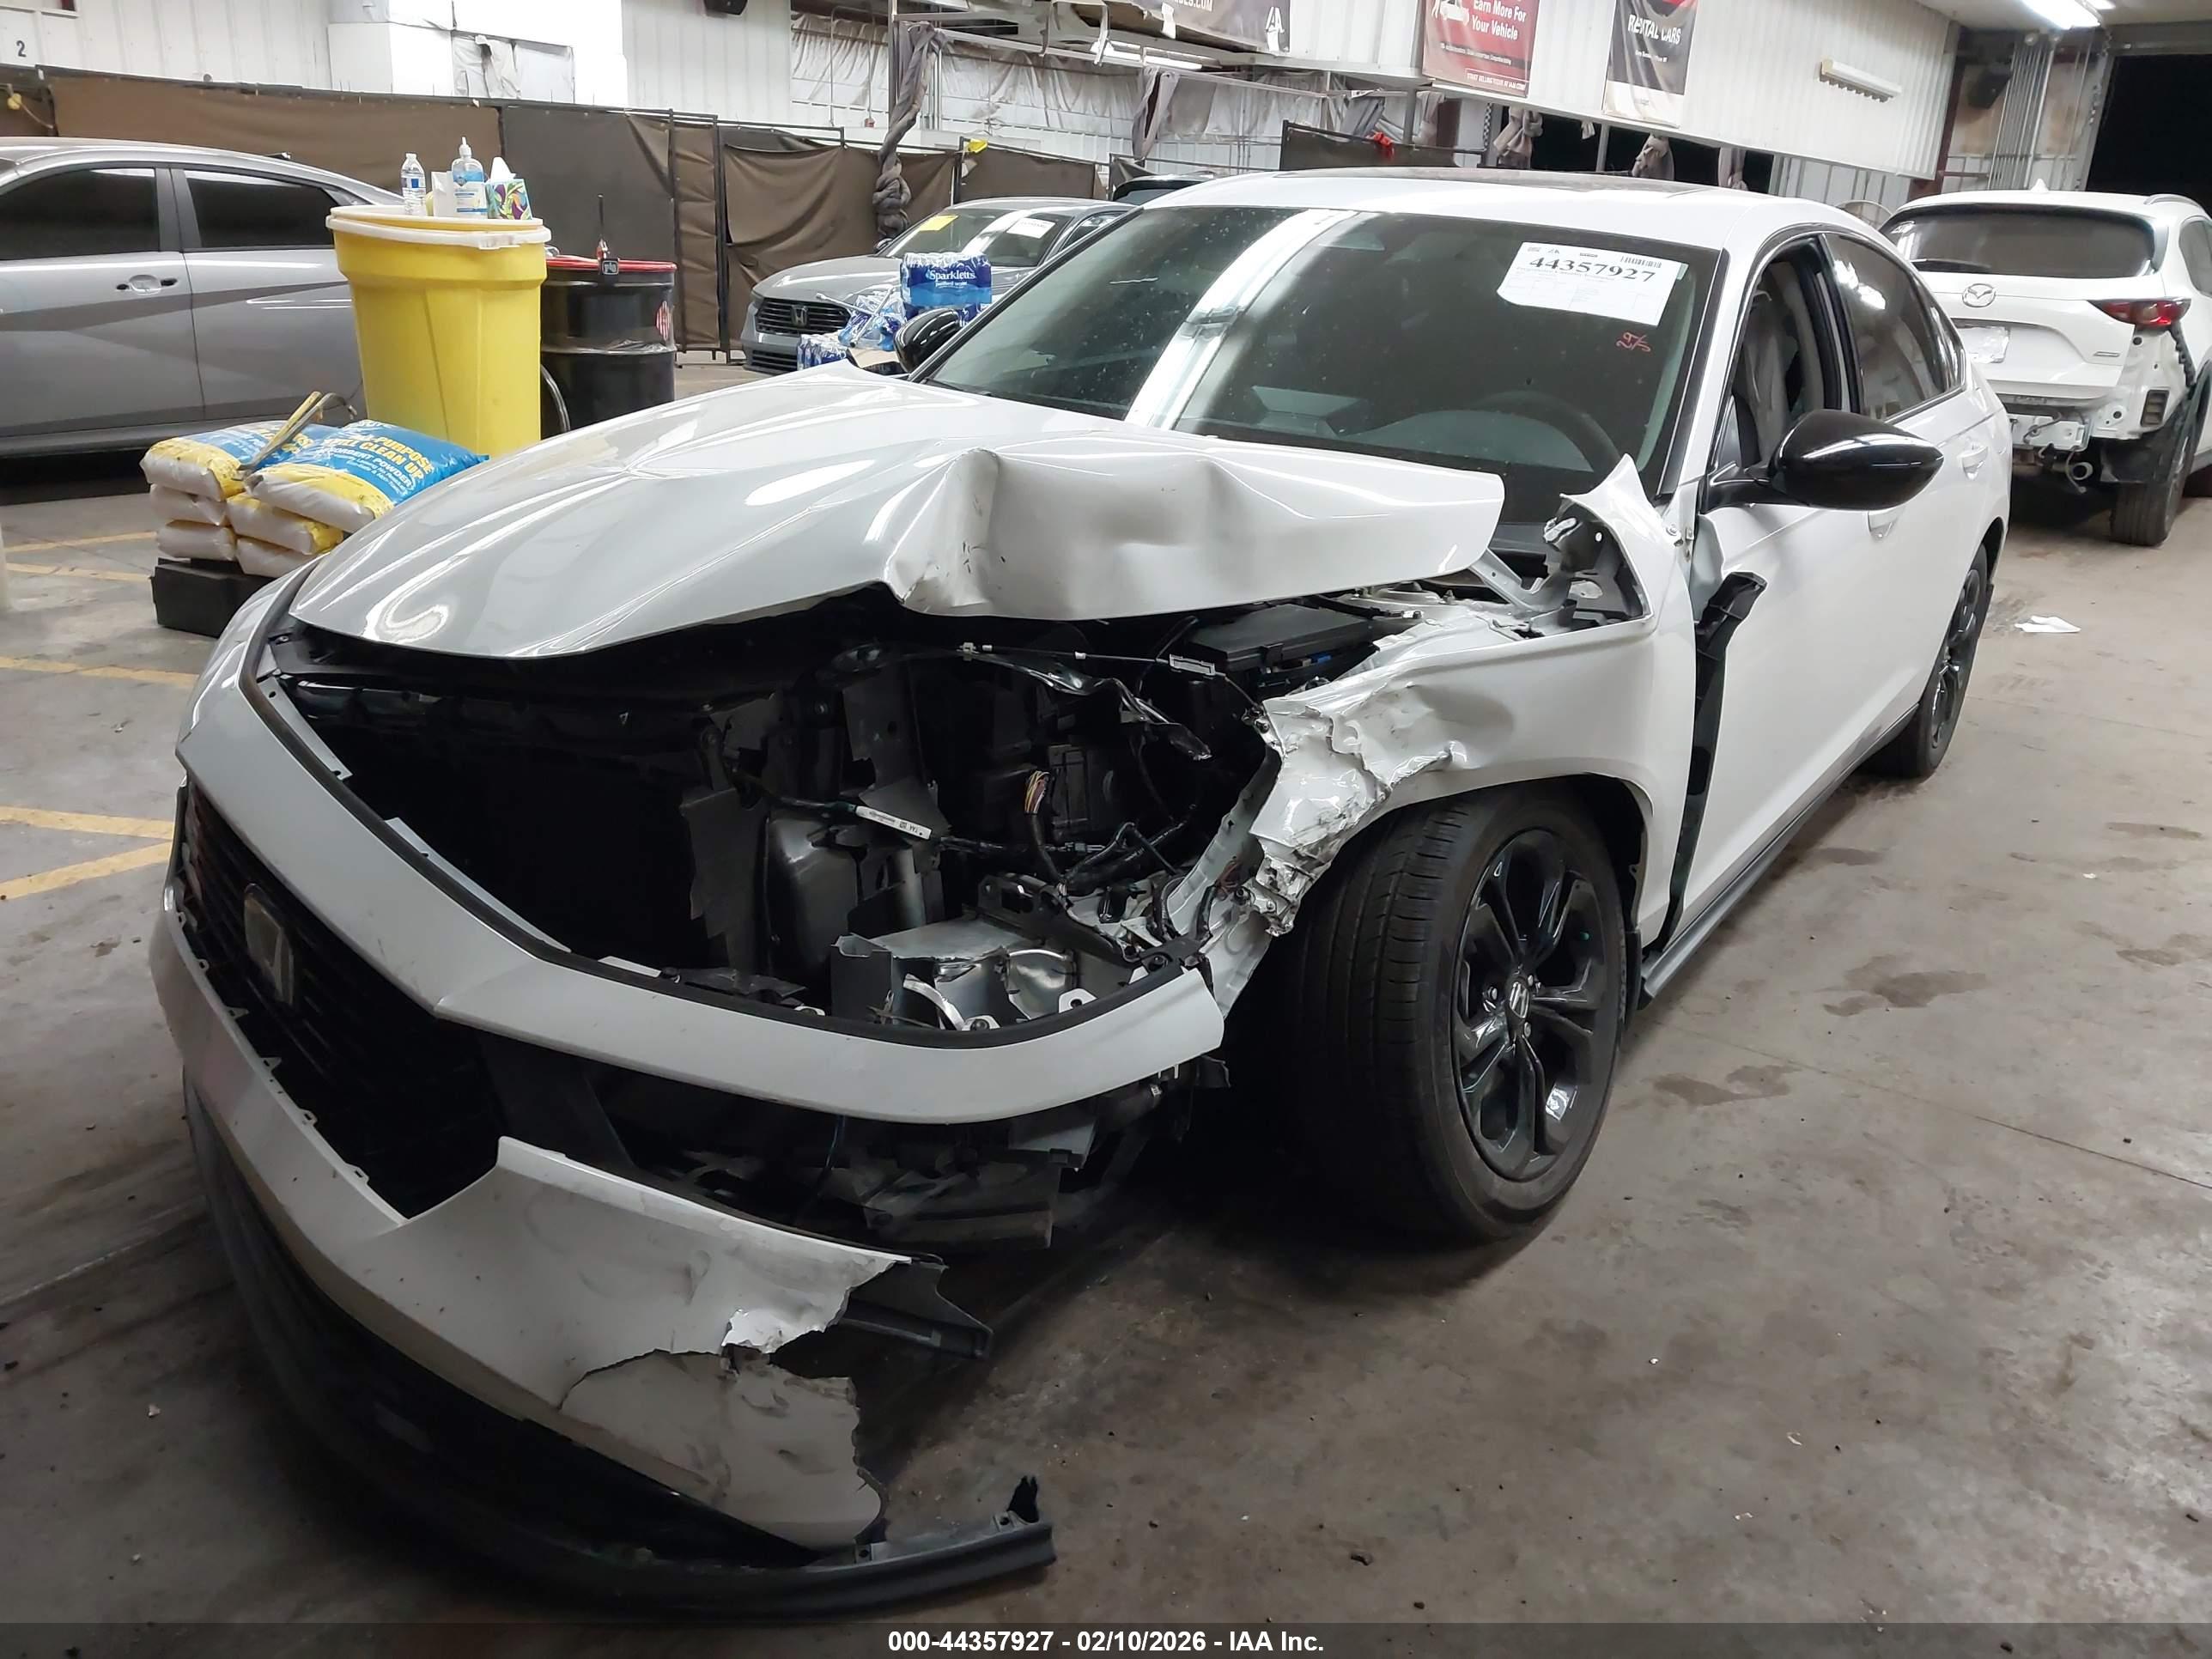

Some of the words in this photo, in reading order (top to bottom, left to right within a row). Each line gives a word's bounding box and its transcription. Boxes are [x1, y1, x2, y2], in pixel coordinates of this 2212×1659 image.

[1473, 0, 1492, 13] Earn
[1493, 0, 1512, 18] More
[1514, 6, 1527, 22] For
[1472, 15, 1490, 33] Your
[1492, 20, 1518, 40] Vehicle
[16, 40, 27, 58] 2
[929, 270, 975, 283] Sparkletts
[1528, 257, 1656, 283] 44357927
[359, 441, 407, 466] CLEAN
[403, 462, 425, 481] UP
[373, 457, 413, 489] POWDER
